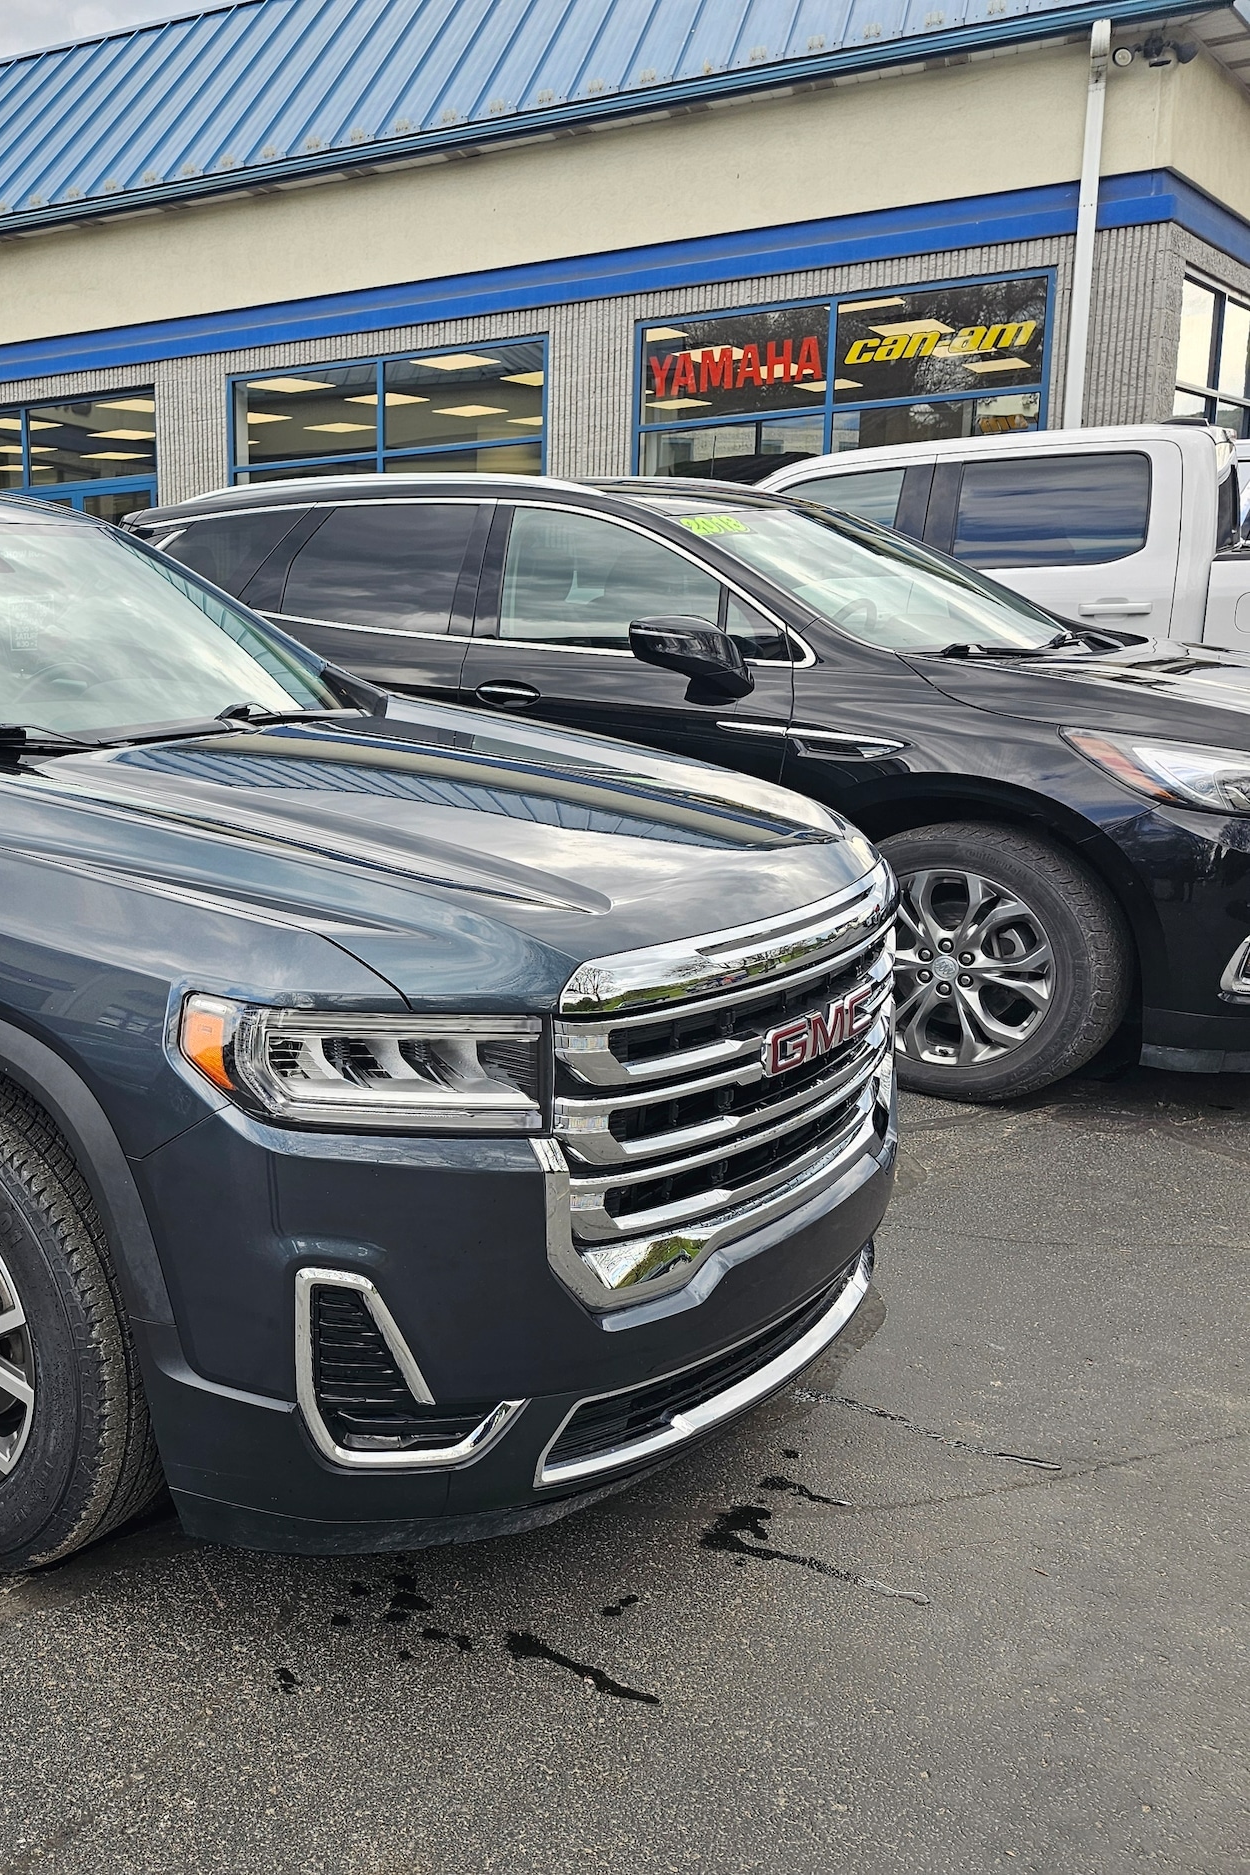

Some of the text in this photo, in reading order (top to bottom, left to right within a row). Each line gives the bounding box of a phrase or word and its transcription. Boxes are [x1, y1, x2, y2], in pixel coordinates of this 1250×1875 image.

[649, 336, 824, 399] YAMAHA
[844, 319, 1038, 366] can-am
[762, 980, 872, 1078] GMC
